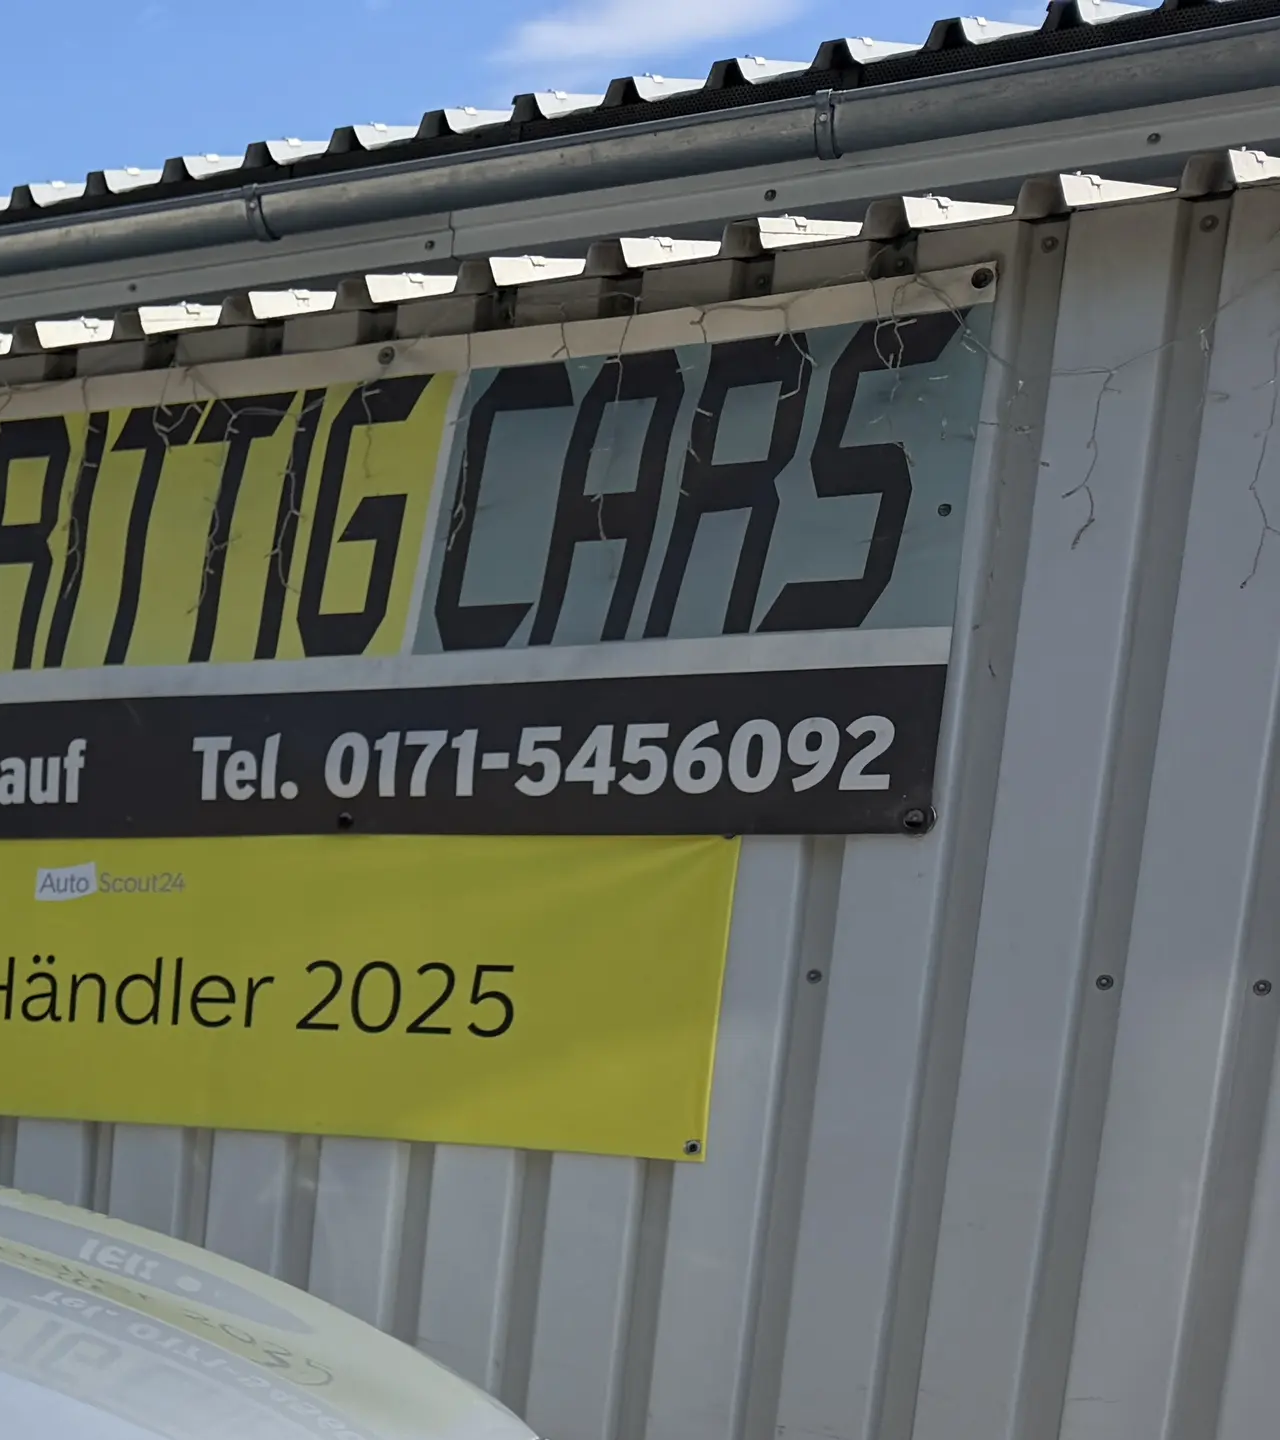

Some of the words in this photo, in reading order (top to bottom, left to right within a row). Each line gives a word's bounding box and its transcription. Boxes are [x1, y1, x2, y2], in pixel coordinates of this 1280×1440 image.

[436, 305, 974, 649] CARS
[192, 732, 298, 800] Tel.
[324, 715, 896, 798] 0171-5456092
[40, 872, 90, 894] Auto
[99, 872, 186, 894] Scout24
[295, 960, 517, 1038] 2025
